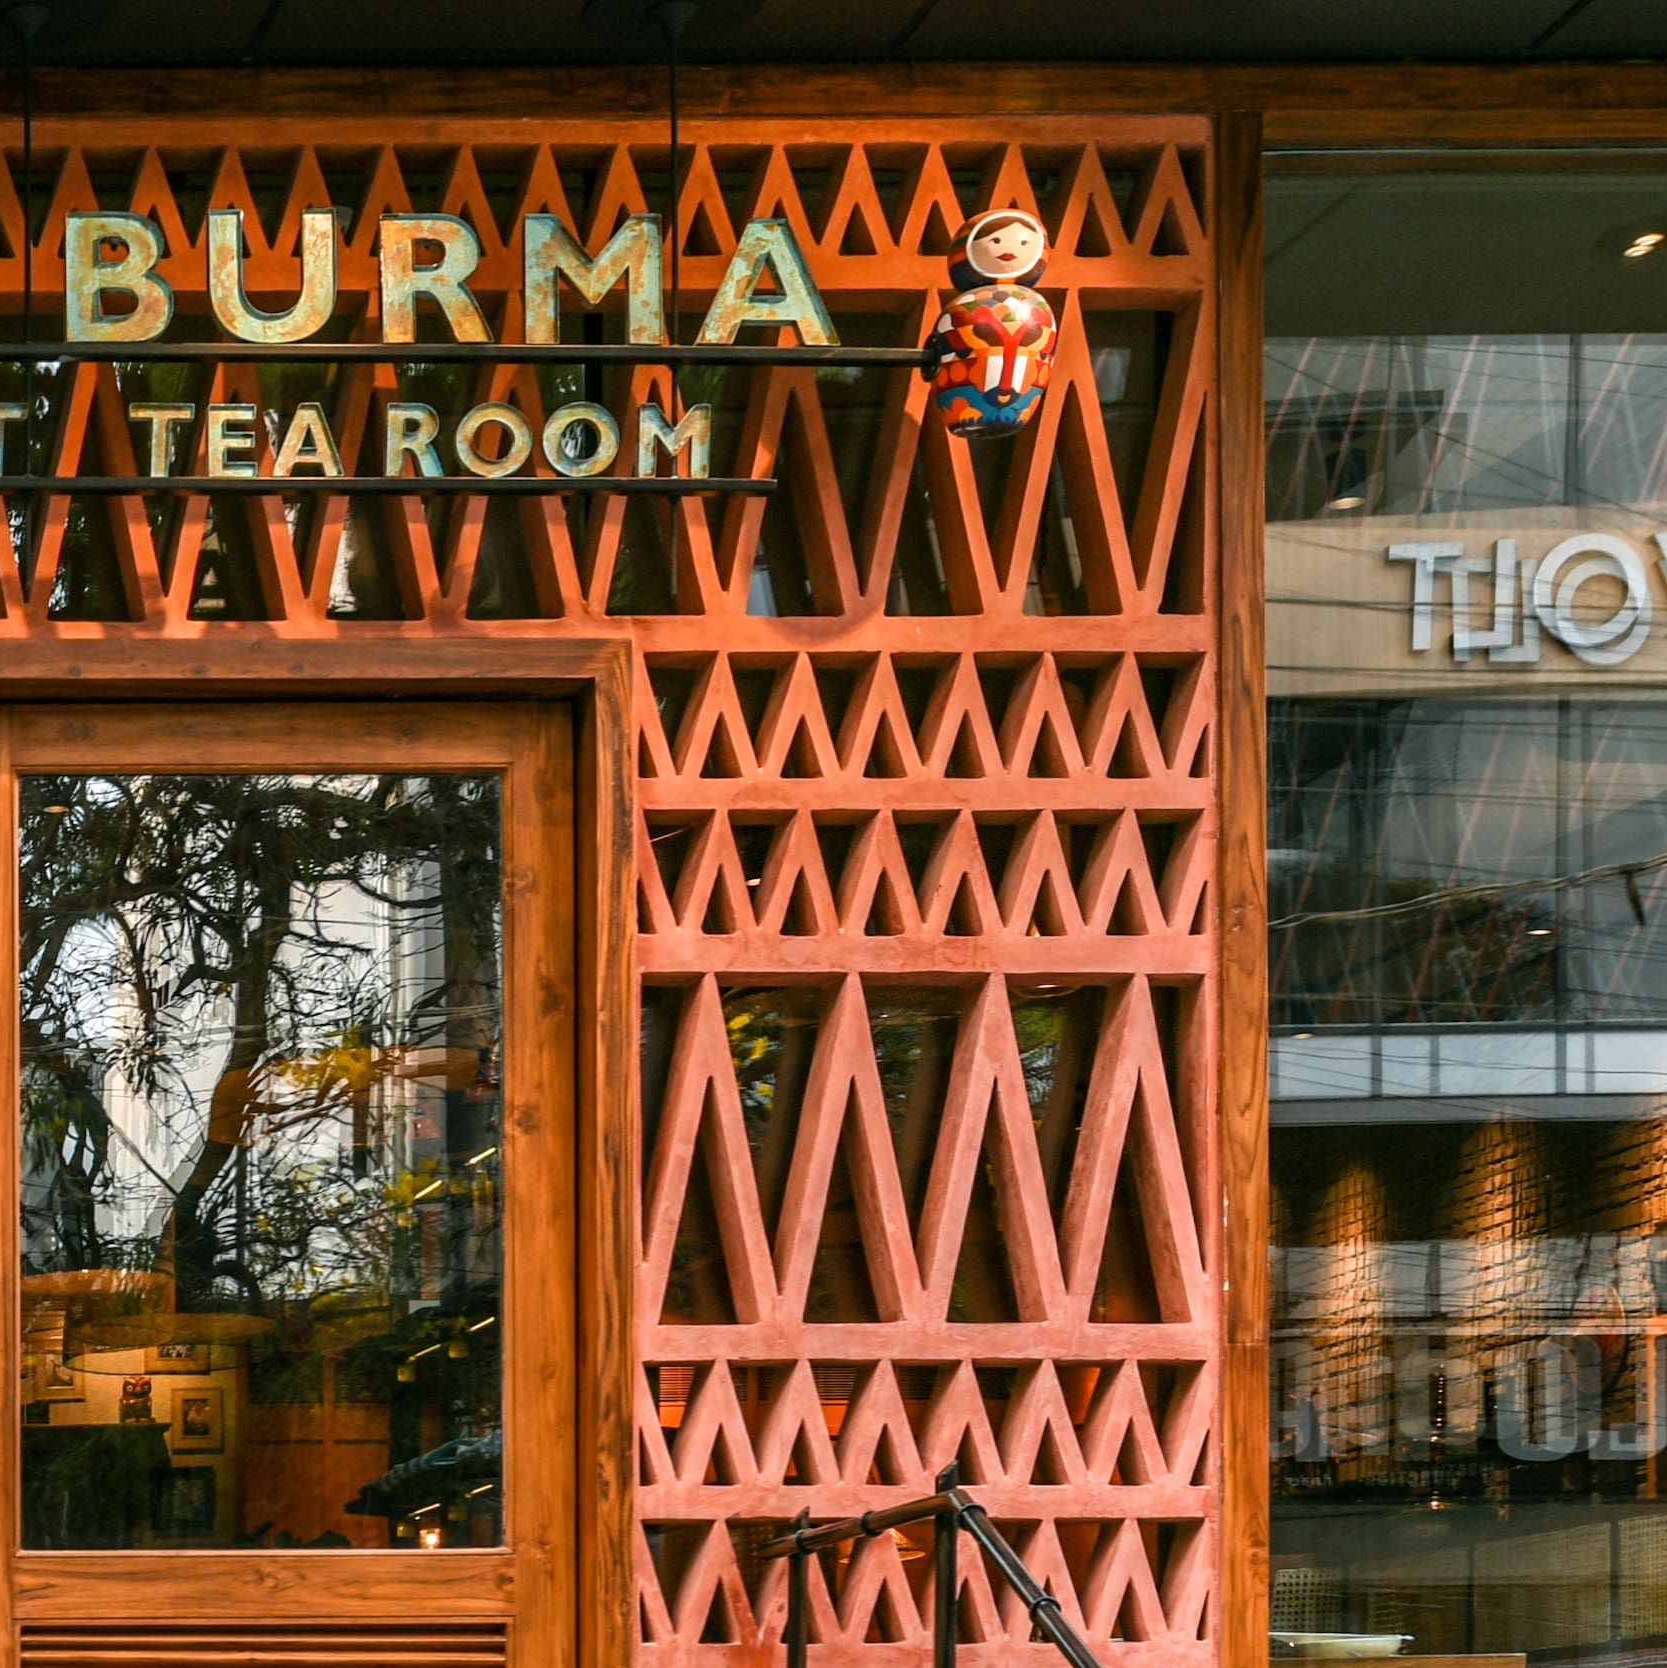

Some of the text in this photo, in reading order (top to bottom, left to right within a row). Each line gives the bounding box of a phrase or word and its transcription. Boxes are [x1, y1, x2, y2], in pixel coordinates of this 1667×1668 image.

[64, 207, 841, 345] BURMA
[128, 401, 344, 478] TEA
[386, 401, 713, 479] ROOM
